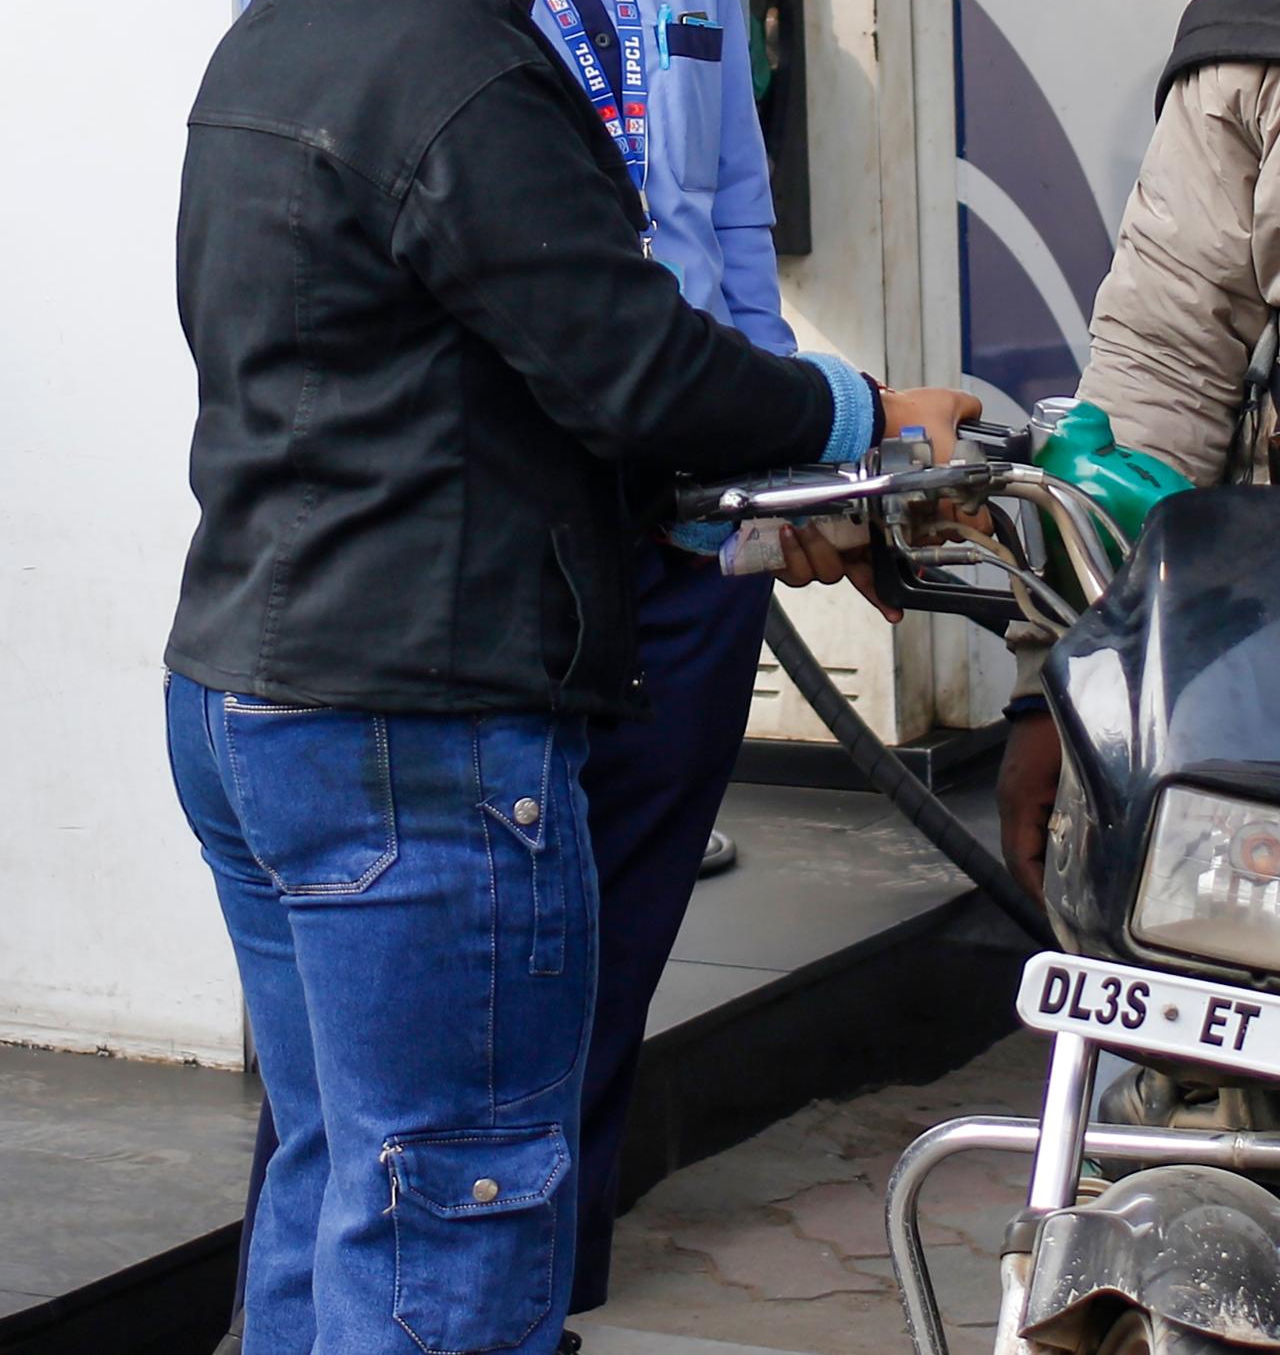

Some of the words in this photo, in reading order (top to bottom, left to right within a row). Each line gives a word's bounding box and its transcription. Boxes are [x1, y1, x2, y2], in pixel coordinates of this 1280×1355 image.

[575, 43, 605, 91] HPCL
[625, 36, 641, 86] HPCL
[1037, 966, 1151, 1029] DL3S
[1199, 998, 1261, 1051] ET
